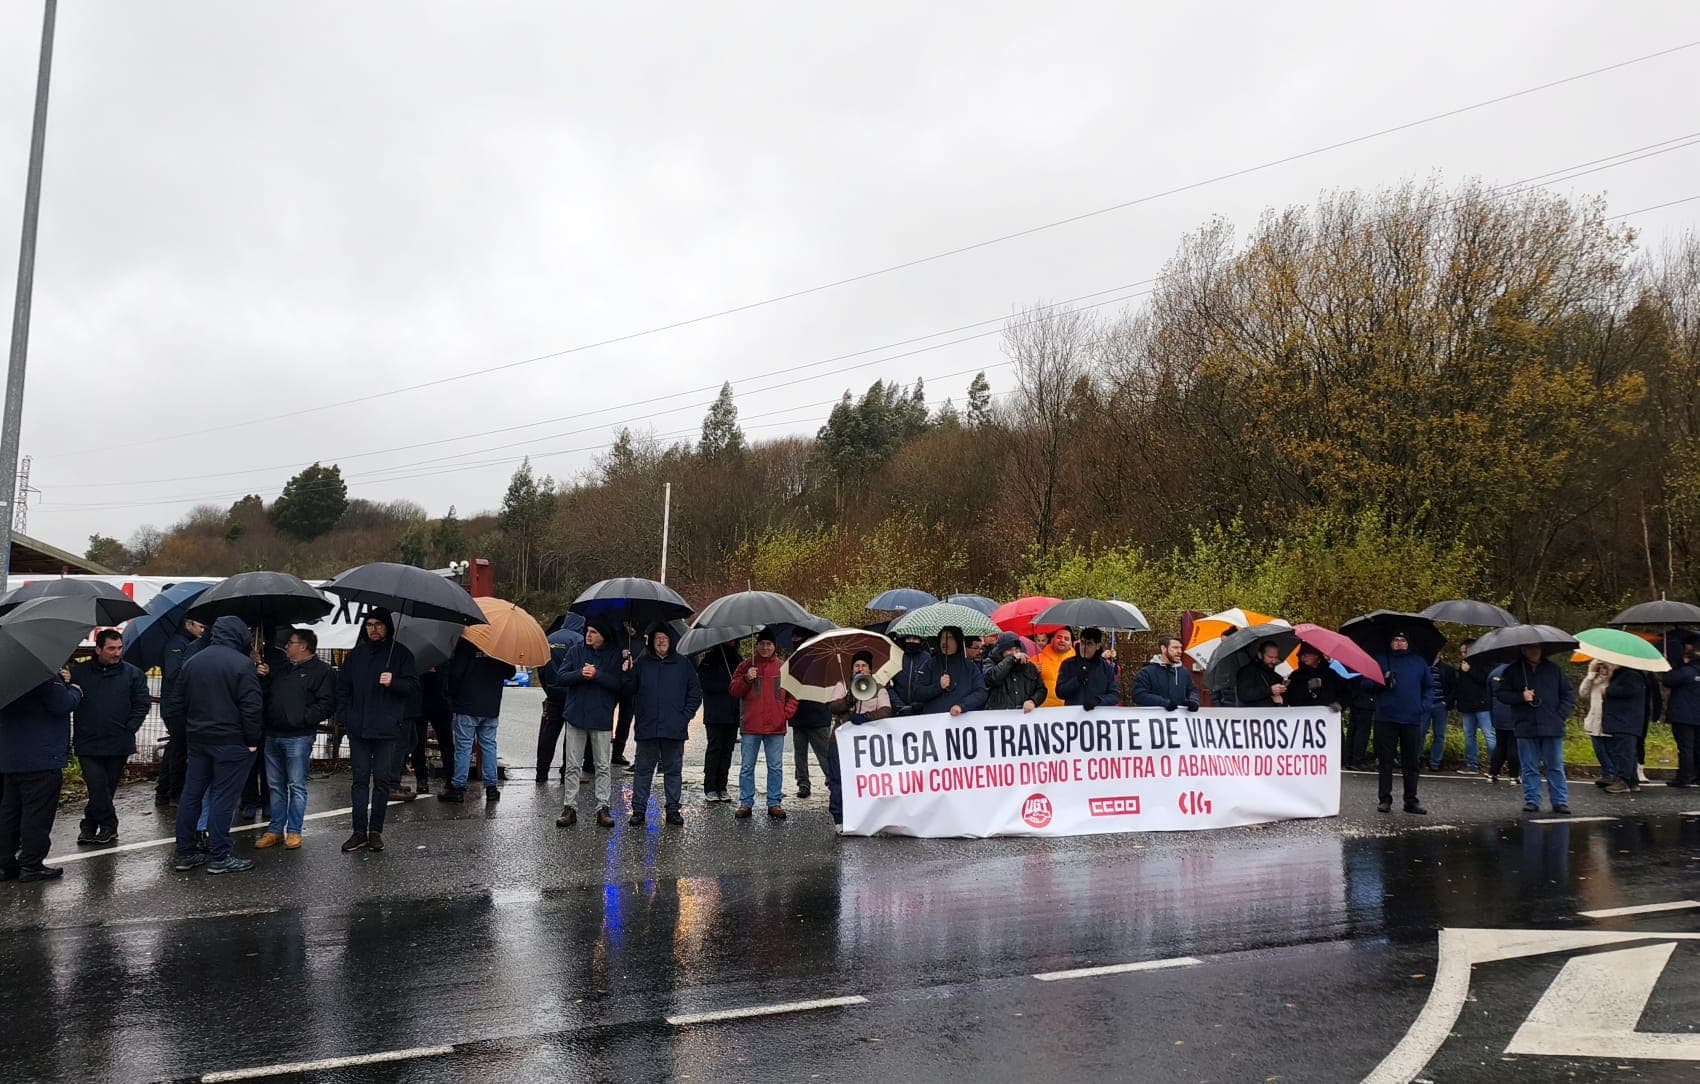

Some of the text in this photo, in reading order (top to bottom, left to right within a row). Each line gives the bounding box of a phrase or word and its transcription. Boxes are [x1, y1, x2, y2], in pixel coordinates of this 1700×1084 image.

[853, 718, 1327, 768] FOLGA NO TRANSPORTE DE VIAXEIROS/AS
[856, 755, 1327, 798] POR UN CONVENIO DIGNO E CONTRA O ABANDONO DO SECTOR
[1025, 798, 1048, 814] UGT
[1091, 799, 1137, 813] CCOO
[1178, 791, 1212, 815] CIG
